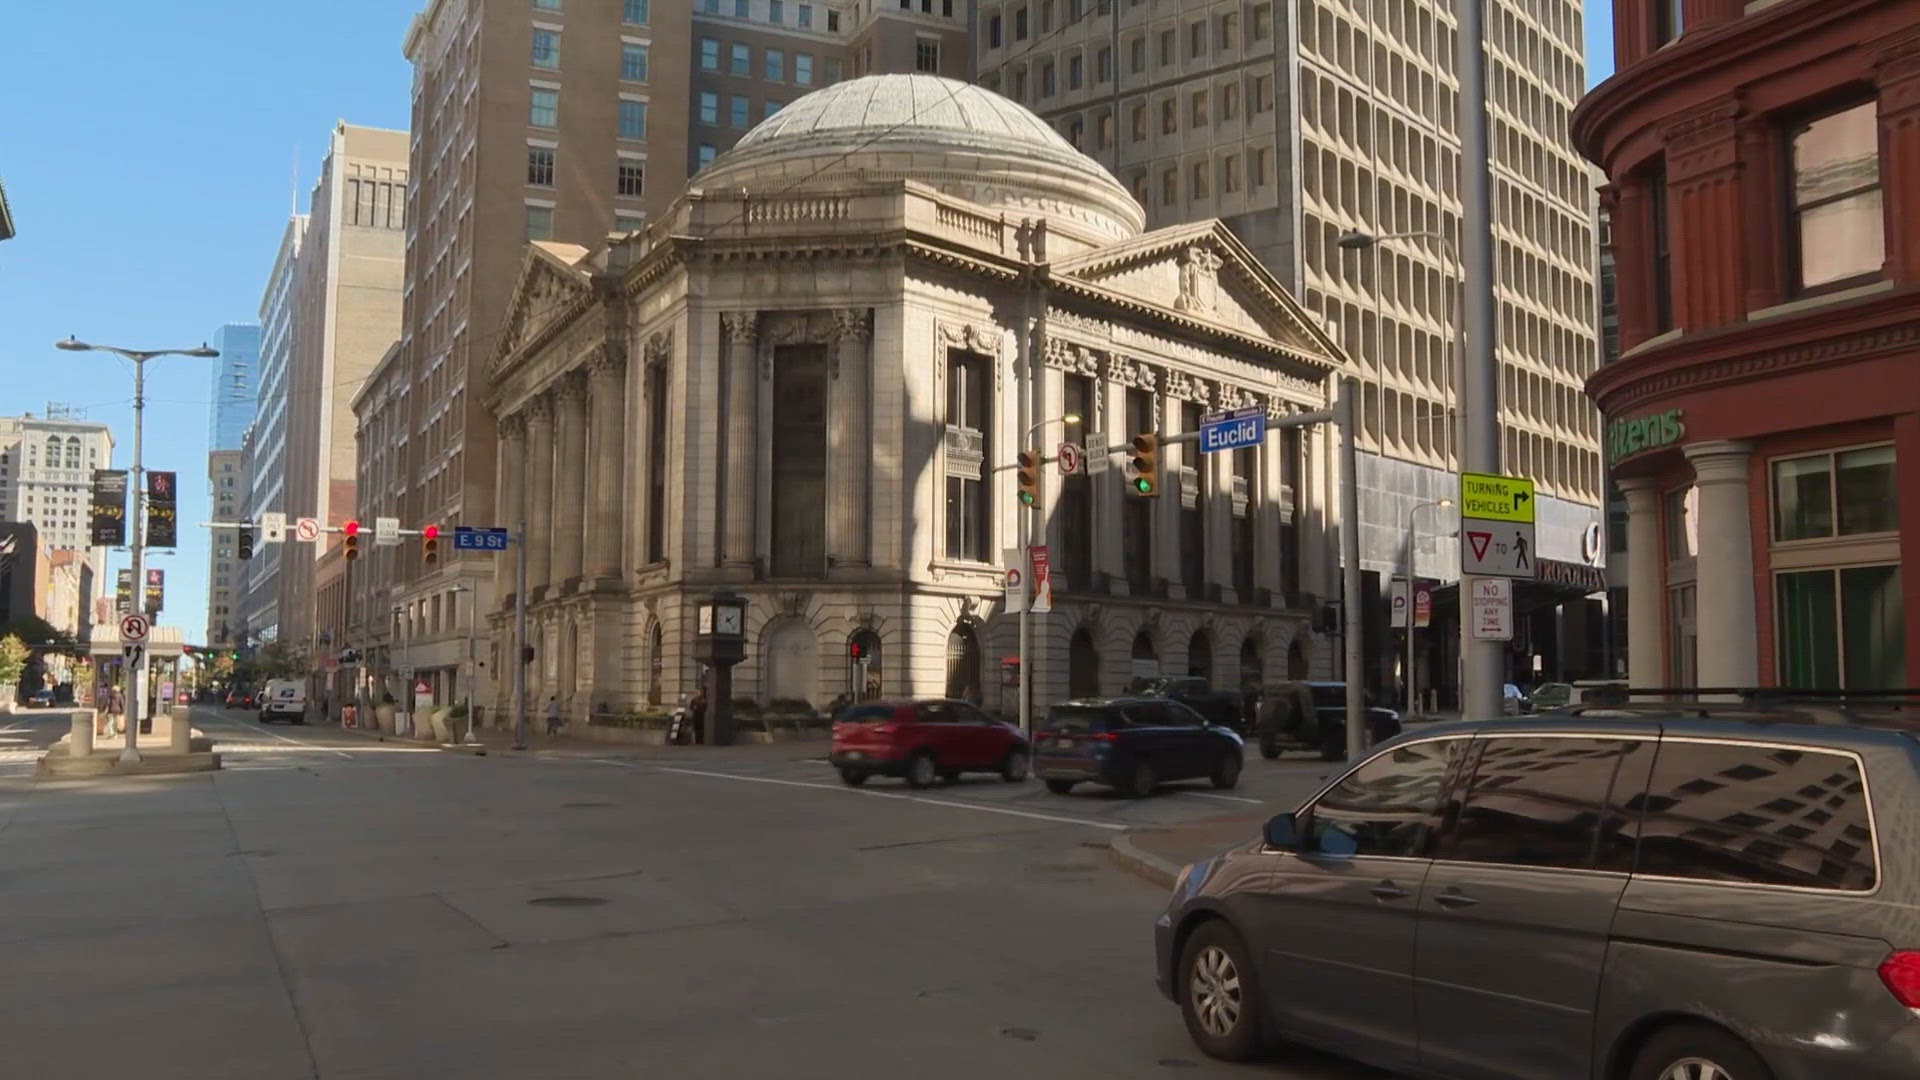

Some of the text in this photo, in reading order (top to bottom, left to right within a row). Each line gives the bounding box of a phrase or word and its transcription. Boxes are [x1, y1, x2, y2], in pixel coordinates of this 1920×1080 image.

[1208, 421, 1257, 448] Euclid
[1467, 482, 1509, 497] TURNING
[1465, 499, 1511, 515] VEHICLES
[460, 534, 503, 548] E. 9 St
[1495, 543, 1508, 555] TO
[1483, 585, 1498, 596] NO
[1474, 597, 1508, 606] STOPPING
[1484, 608, 1499, 616] ANY
[1483, 617, 1500, 626] TIME
